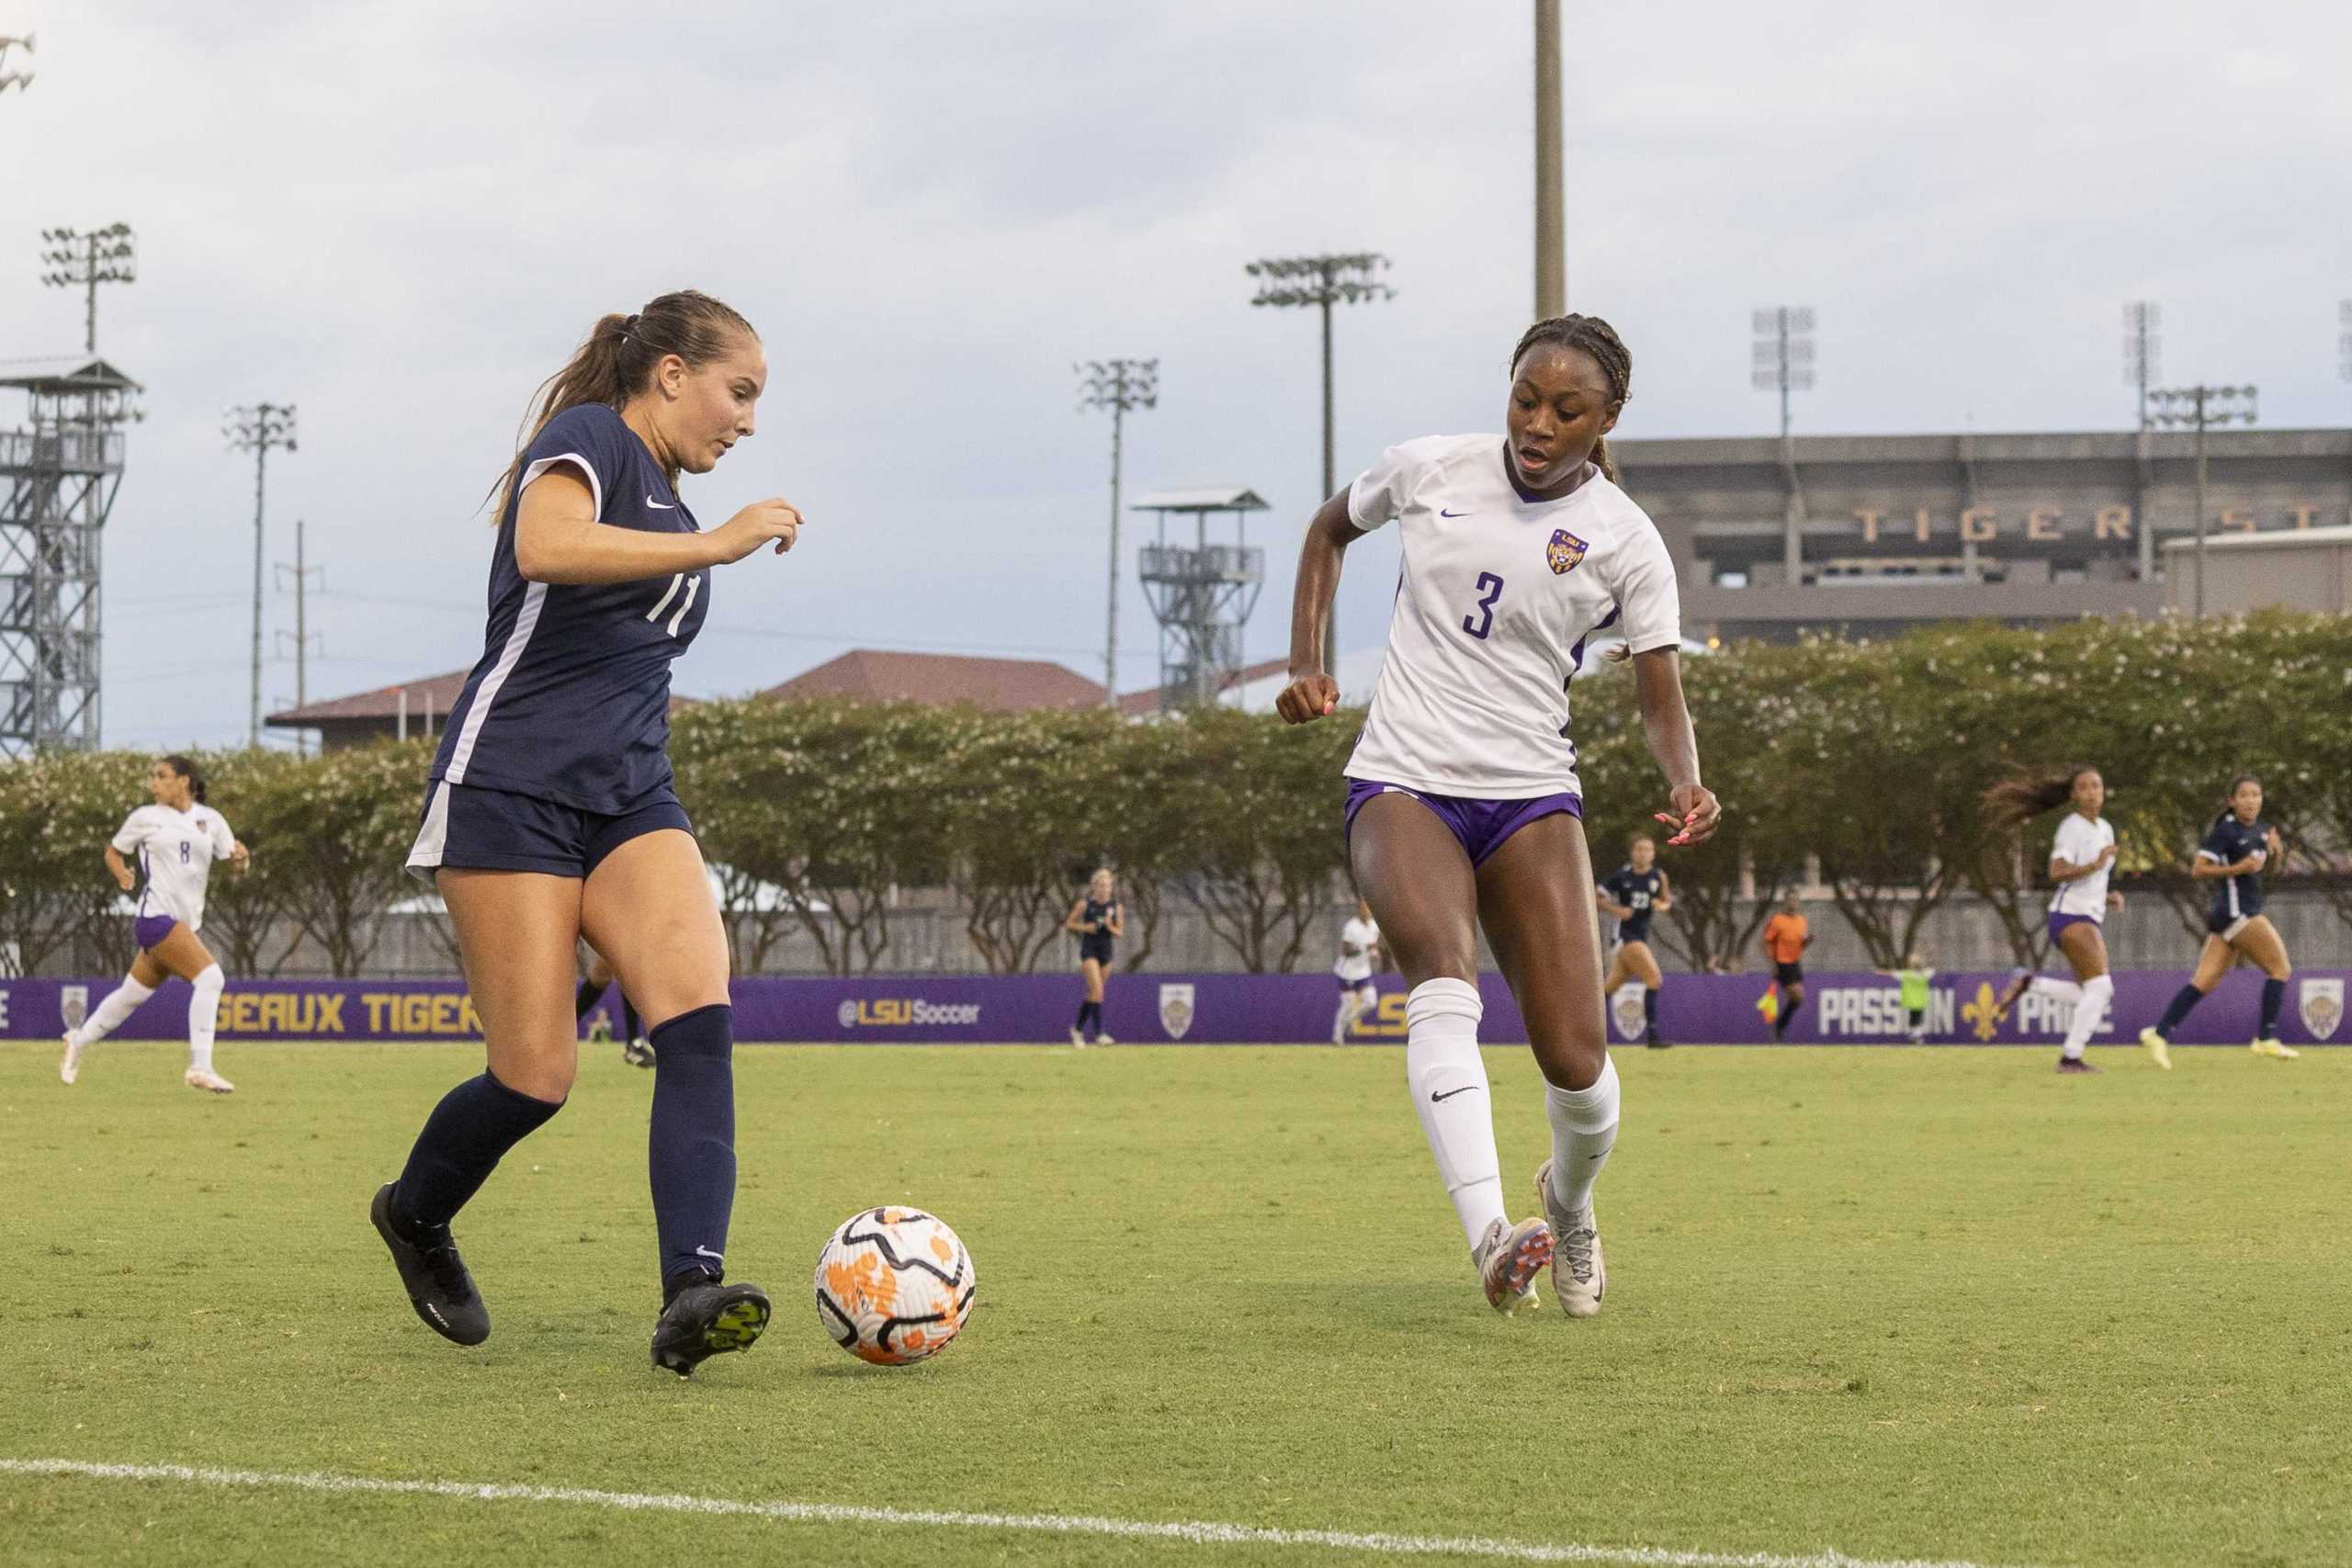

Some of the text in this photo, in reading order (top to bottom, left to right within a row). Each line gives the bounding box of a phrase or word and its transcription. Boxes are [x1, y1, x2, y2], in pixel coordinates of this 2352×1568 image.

[1853, 507, 2132, 543] TIGER
[645, 573, 701, 637] 11
[1463, 571, 1504, 639] 3
[180, 840, 190, 864] 8
[838, 998, 980, 1027] @LSUSoccer
